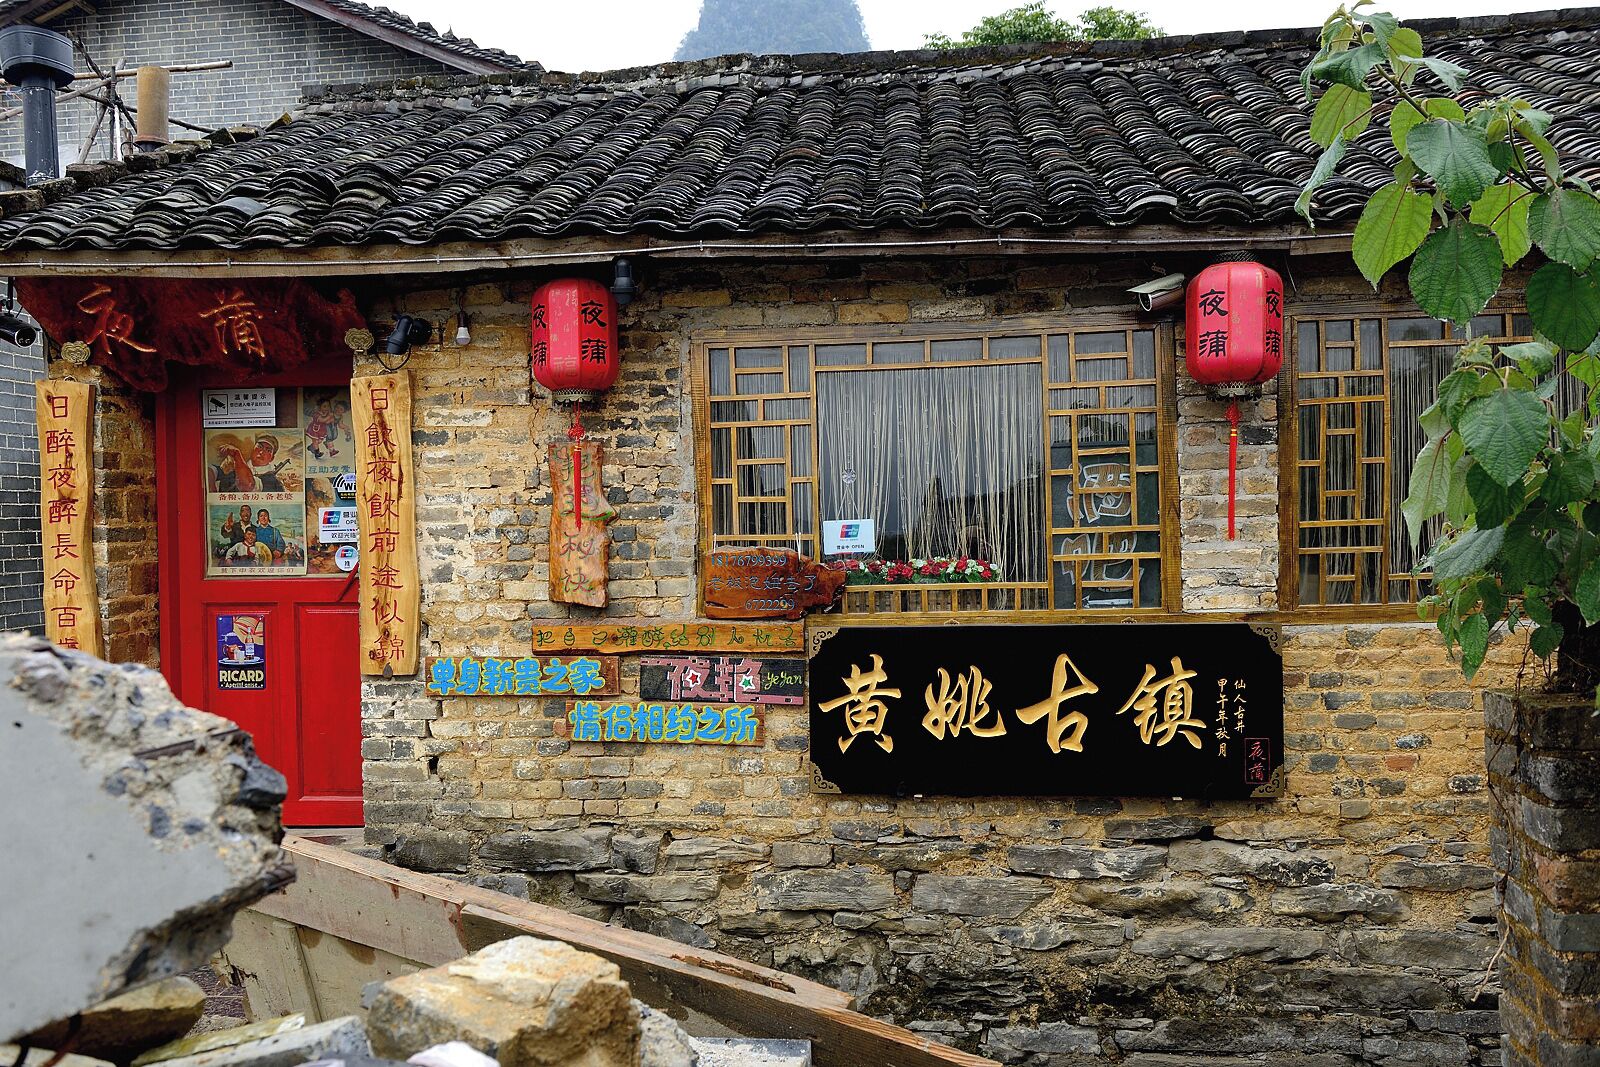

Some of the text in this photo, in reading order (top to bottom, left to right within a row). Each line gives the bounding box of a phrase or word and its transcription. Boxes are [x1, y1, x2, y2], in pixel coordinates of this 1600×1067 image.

[581, 299, 608, 365] 夜蒲
[1199, 288, 1229, 358] 夜蒲
[1265, 288, 1281, 358] 夜蒲
[711, 554, 788, 567] 18176799399
[219, 670, 264, 682] RICARD
[427, 656, 606, 696] 单身新贵之家
[570, 702, 760, 744] 情侣相约之所
